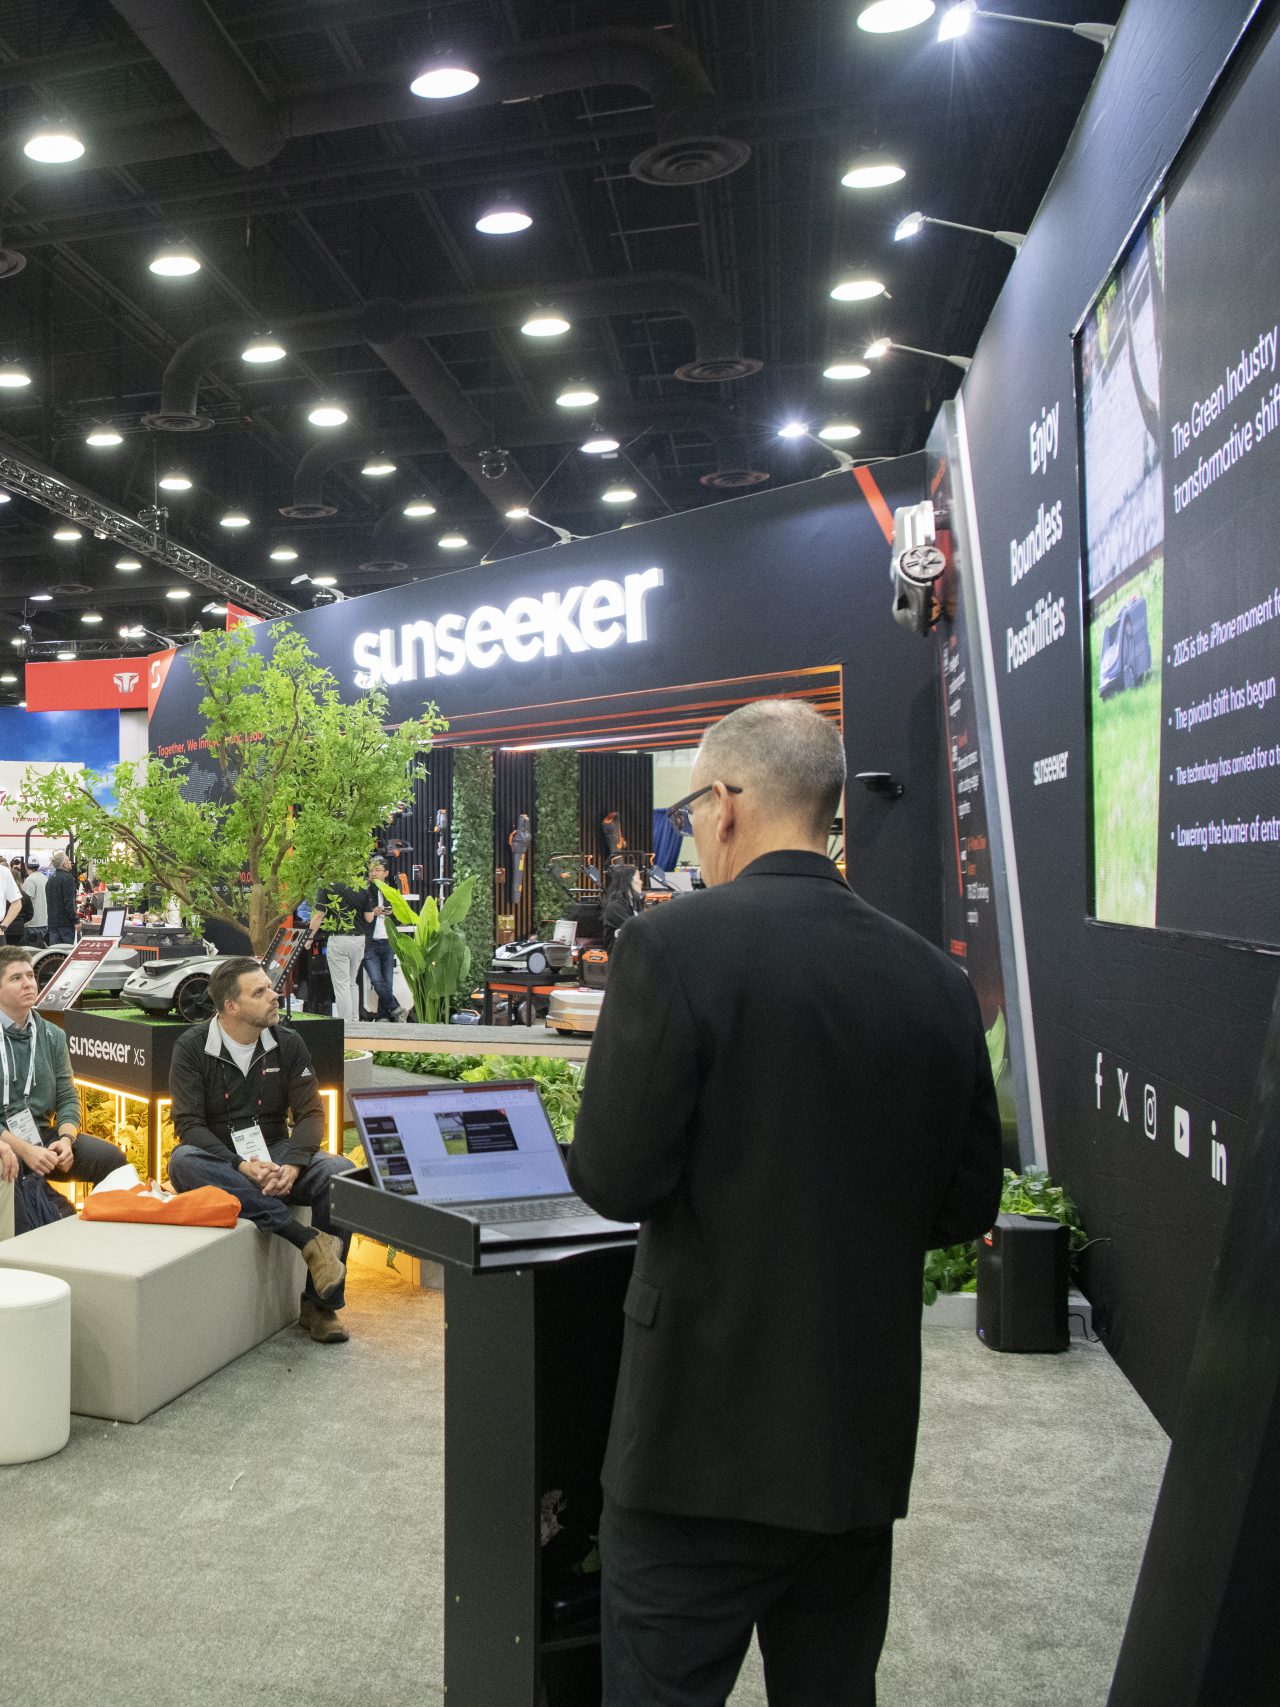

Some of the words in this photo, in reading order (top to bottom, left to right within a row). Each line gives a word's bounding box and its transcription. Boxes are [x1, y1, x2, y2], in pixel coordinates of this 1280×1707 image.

[1171, 421, 1191, 459] The
[1191, 384, 1225, 439] Green
[1226, 325, 1278, 405] Industry
[1029, 401, 1060, 475] Enjoy
[1173, 423, 1253, 514] transformative
[1255, 383, 1280, 443] shif
[1010, 500, 1063, 587] Boundless
[353, 567, 664, 689] sunseeker
[1006, 592, 1066, 673] Possibilities
[1173, 637, 1190, 668] 2025
[1190, 635, 1196, 659] is
[1196, 630, 1209, 656] the
[1210, 618, 1237, 649] iPhone
[1236, 595, 1273, 636] moment
[1174, 706, 1188, 730] The
[1188, 693, 1213, 732] pivotal
[1213, 687, 1229, 718] shift
[1230, 685, 1246, 711] has
[1246, 676, 1276, 709] begun
[1033, 750, 1069, 786] sunseeker
[1176, 766, 1187, 785] The
[1187, 759, 1219, 785] technology
[1219, 756, 1232, 776] has
[1232, 750, 1256, 774] arrived
[1257, 746, 1268, 769] for
[1268, 748, 1275, 766] a
[1177, 822, 1208, 852] Lowering
[1208, 820, 1221, 845] the
[1222, 817, 1249, 844] barrier
[1249, 814, 1260, 842] of
[1260, 815, 1280, 843] entr
[69, 1035, 131, 1064] sunseeker
[133, 1048, 145, 1066] X5
